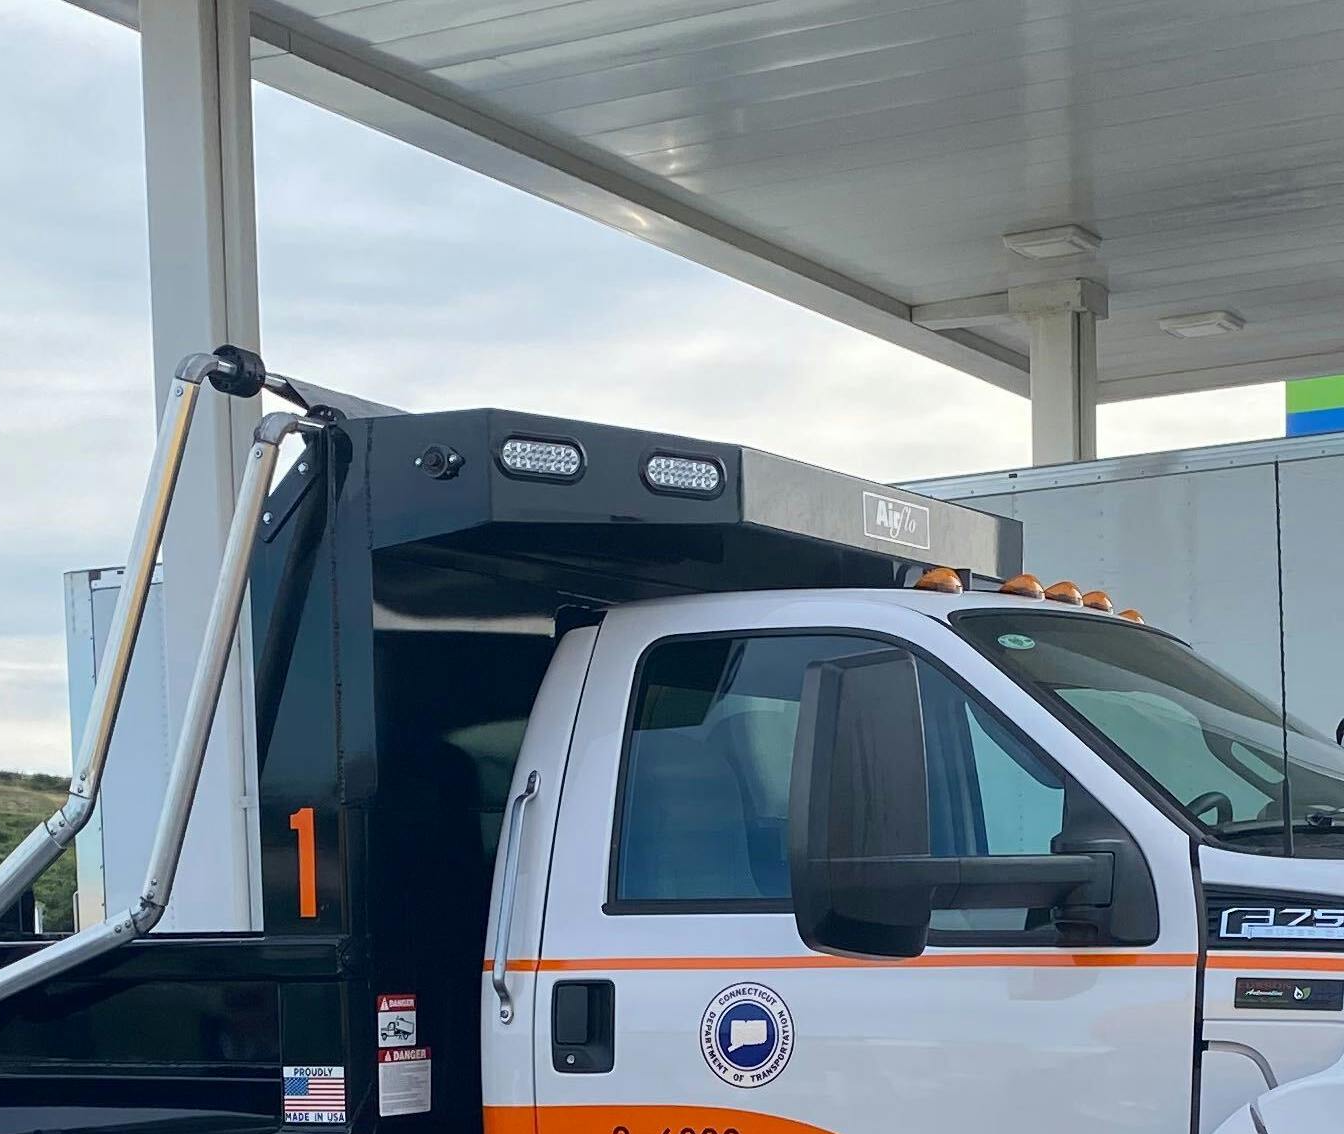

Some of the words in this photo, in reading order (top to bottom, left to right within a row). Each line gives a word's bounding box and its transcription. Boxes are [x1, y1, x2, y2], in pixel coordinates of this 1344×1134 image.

[876, 500, 916, 538] Airflo
[290, 808, 316, 917] 1
[718, 988, 777, 1006] CONNECTICUT
[393, 1049, 427, 1061] DANGER
[704, 1011, 729, 1074] DEPARTMENT
[733, 1073, 745, 1082] OF
[750, 1010, 789, 1083] TRANSPORTATION
[293, 1067, 333, 1077] PROUDLY
[285, 1112, 310, 1122] MADE
[314, 1112, 324, 1122] IN
[327, 1112, 345, 1122] USA
